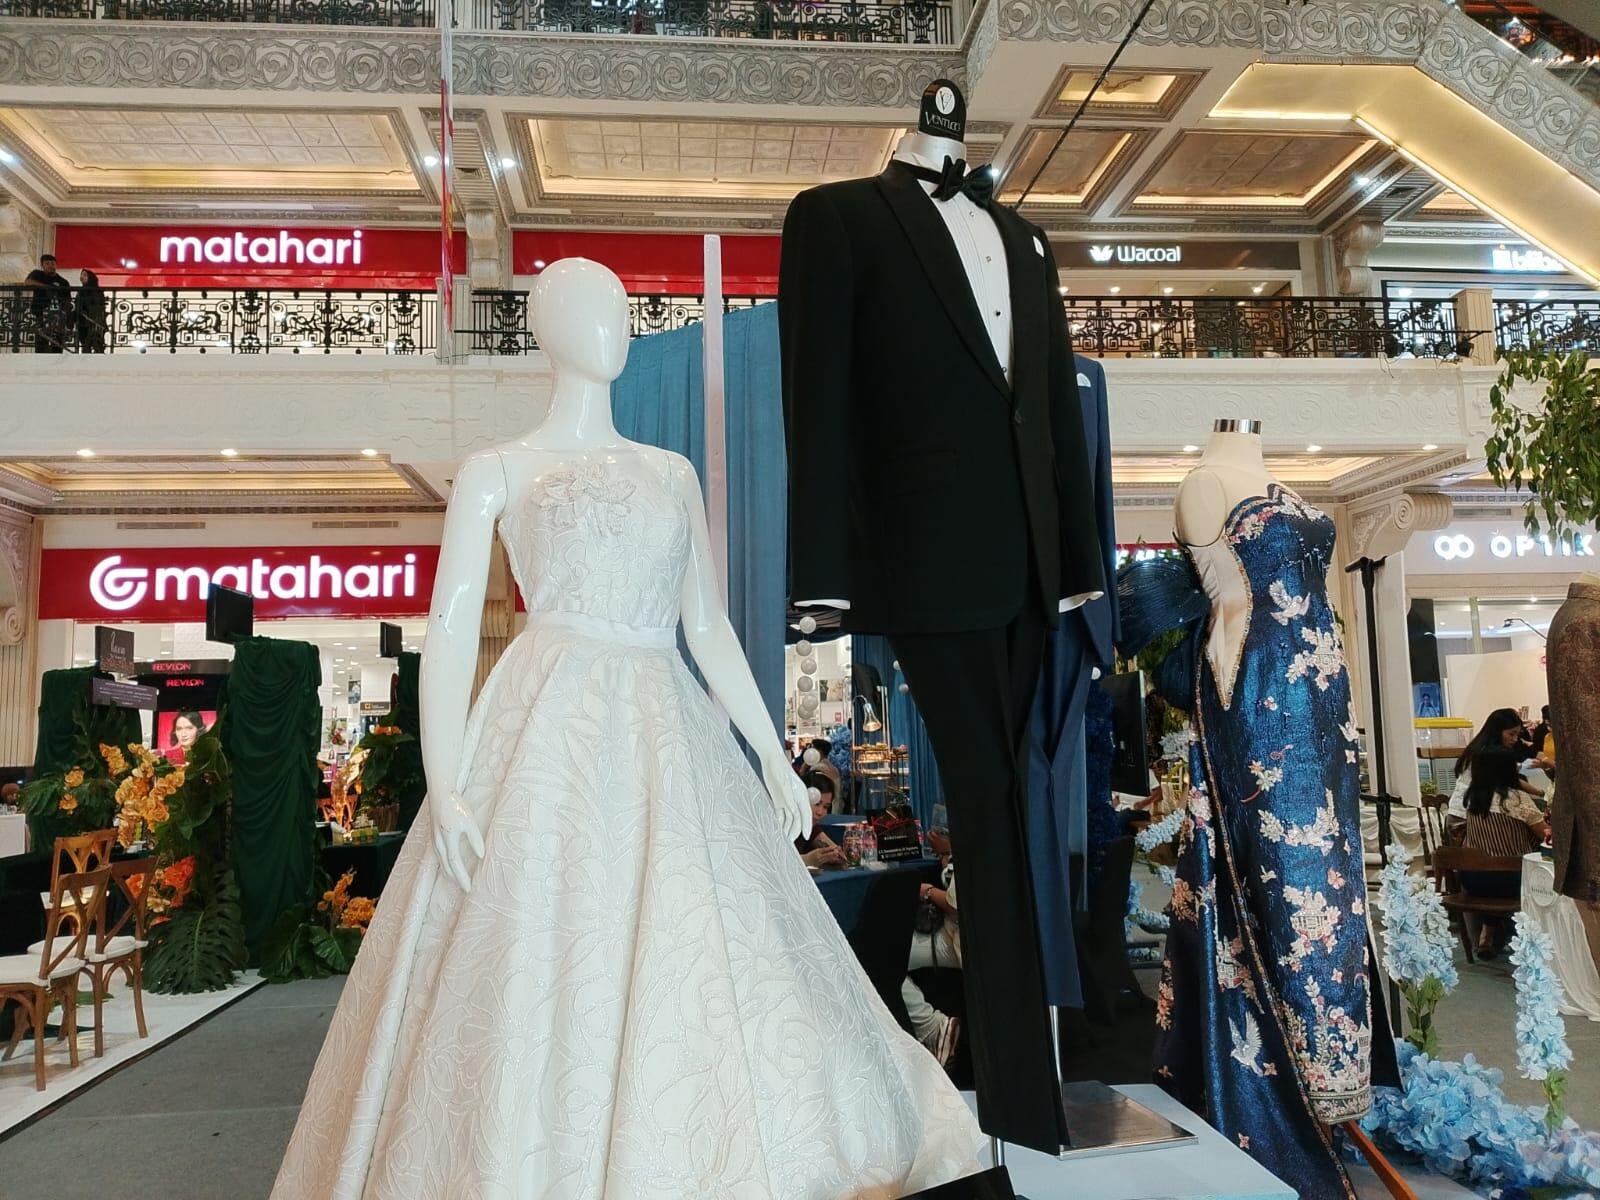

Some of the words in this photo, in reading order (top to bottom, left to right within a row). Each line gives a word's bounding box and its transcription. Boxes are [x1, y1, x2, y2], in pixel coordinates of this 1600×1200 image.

[160, 230, 362, 264] matahari
[1117, 245, 1181, 262] Wacoal
[155, 553, 416, 601] matahari
[151, 662, 192, 672] REVLON
[165, 678, 204, 687] REVLON
